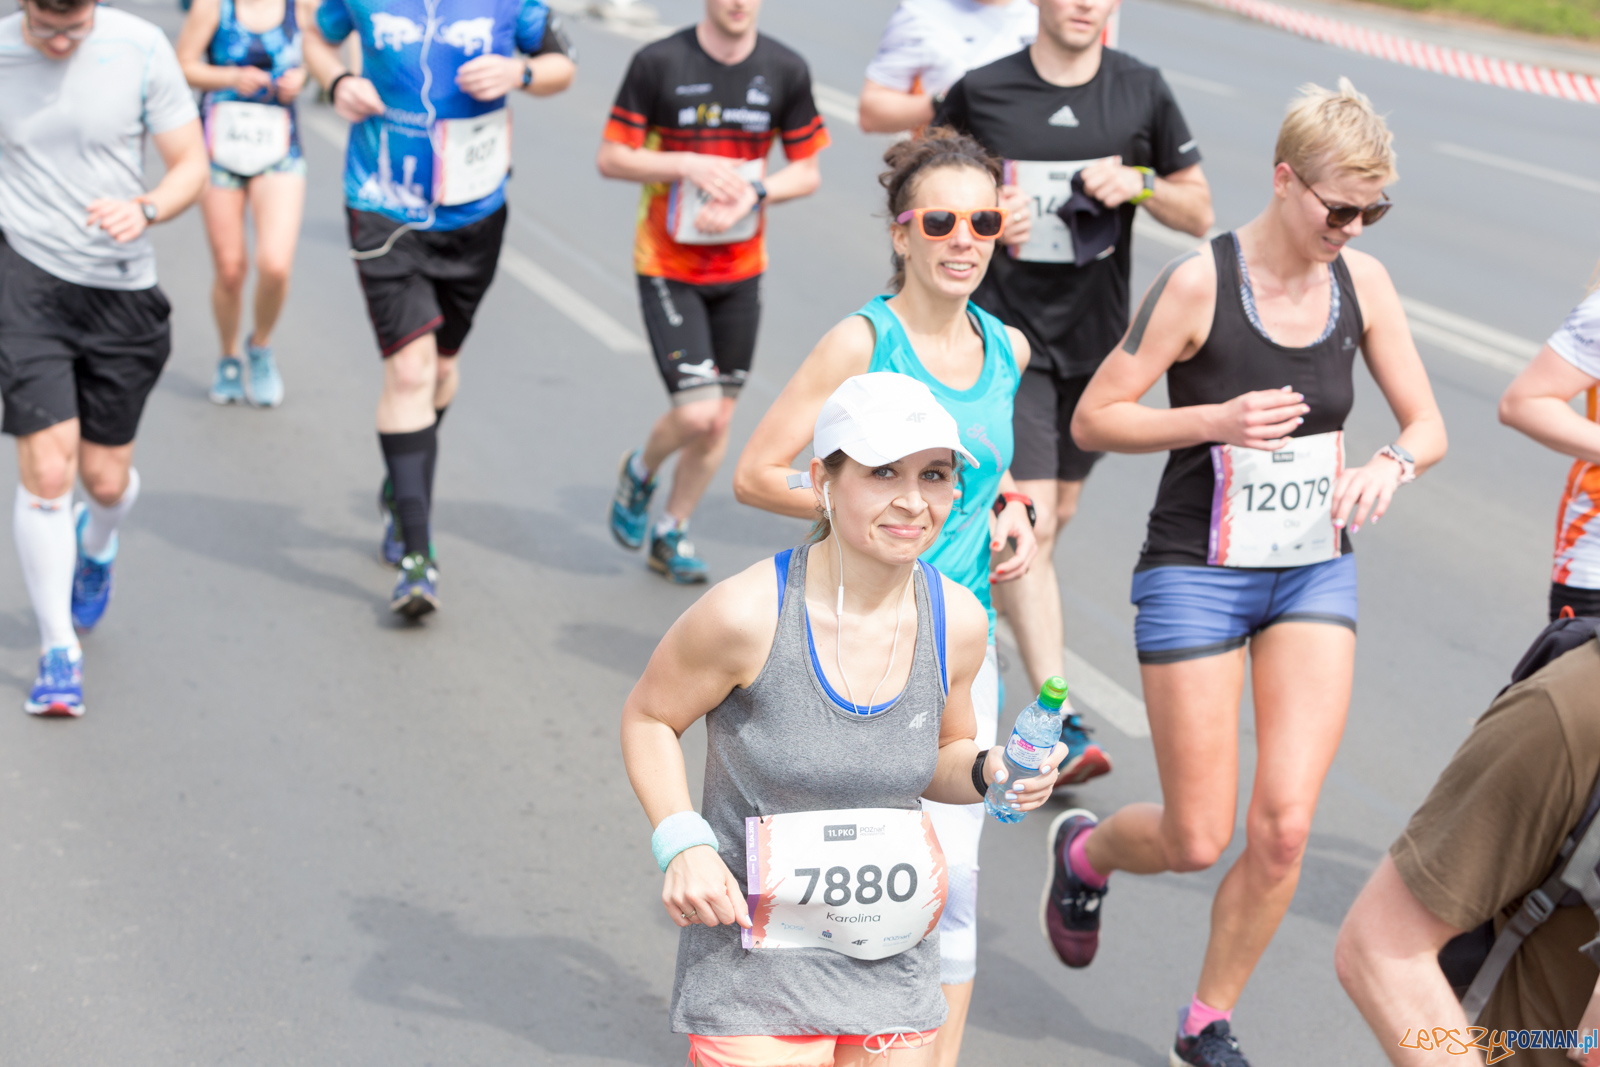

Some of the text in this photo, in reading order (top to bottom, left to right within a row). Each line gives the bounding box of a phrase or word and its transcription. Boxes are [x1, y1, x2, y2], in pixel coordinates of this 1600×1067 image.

[1242, 477, 1330, 512] 12079
[794, 862, 918, 907] 7880
[826, 911, 881, 924] Karolina
